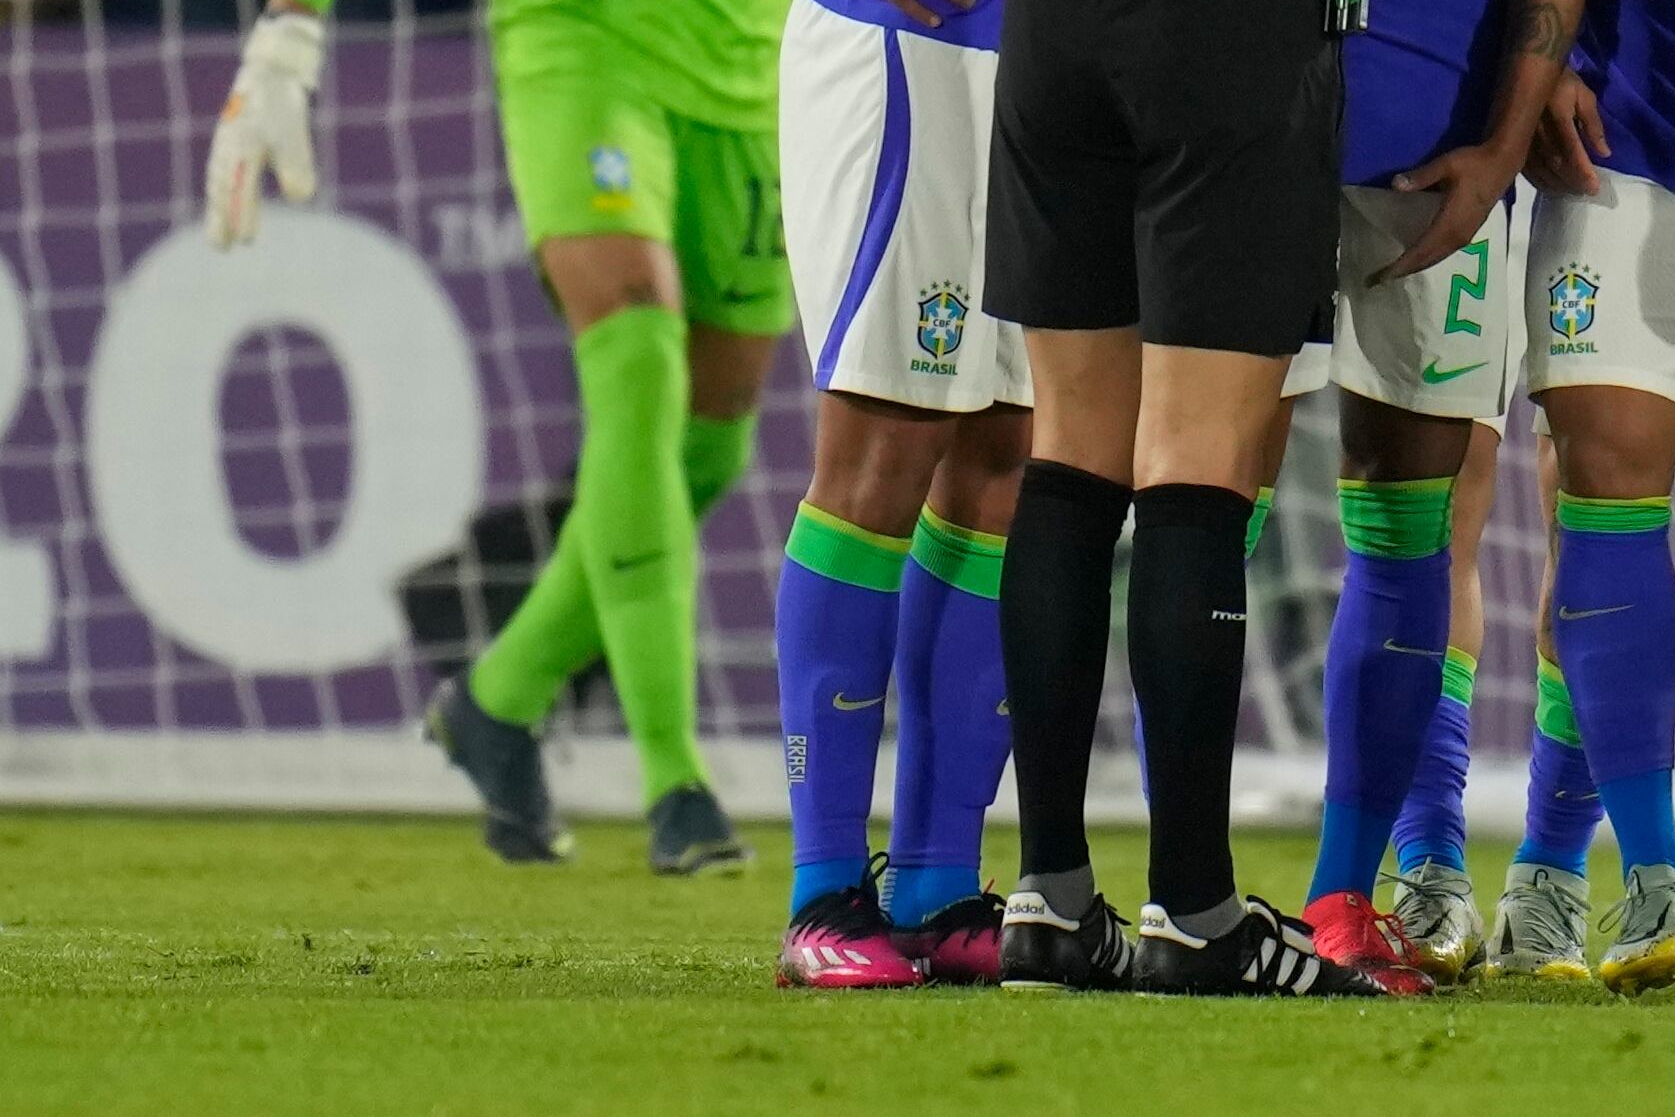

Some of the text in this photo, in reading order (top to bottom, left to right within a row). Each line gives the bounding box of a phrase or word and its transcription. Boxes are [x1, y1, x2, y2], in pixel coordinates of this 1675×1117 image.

[1445, 238, 1489, 337] 2
[1562, 300, 1581, 309] CBF
[932, 318, 951, 327] CBF
[1550, 341, 1599, 356] BRASIL
[910, 359, 958, 376] BRASIL
[787, 735, 807, 789] BRASIL
